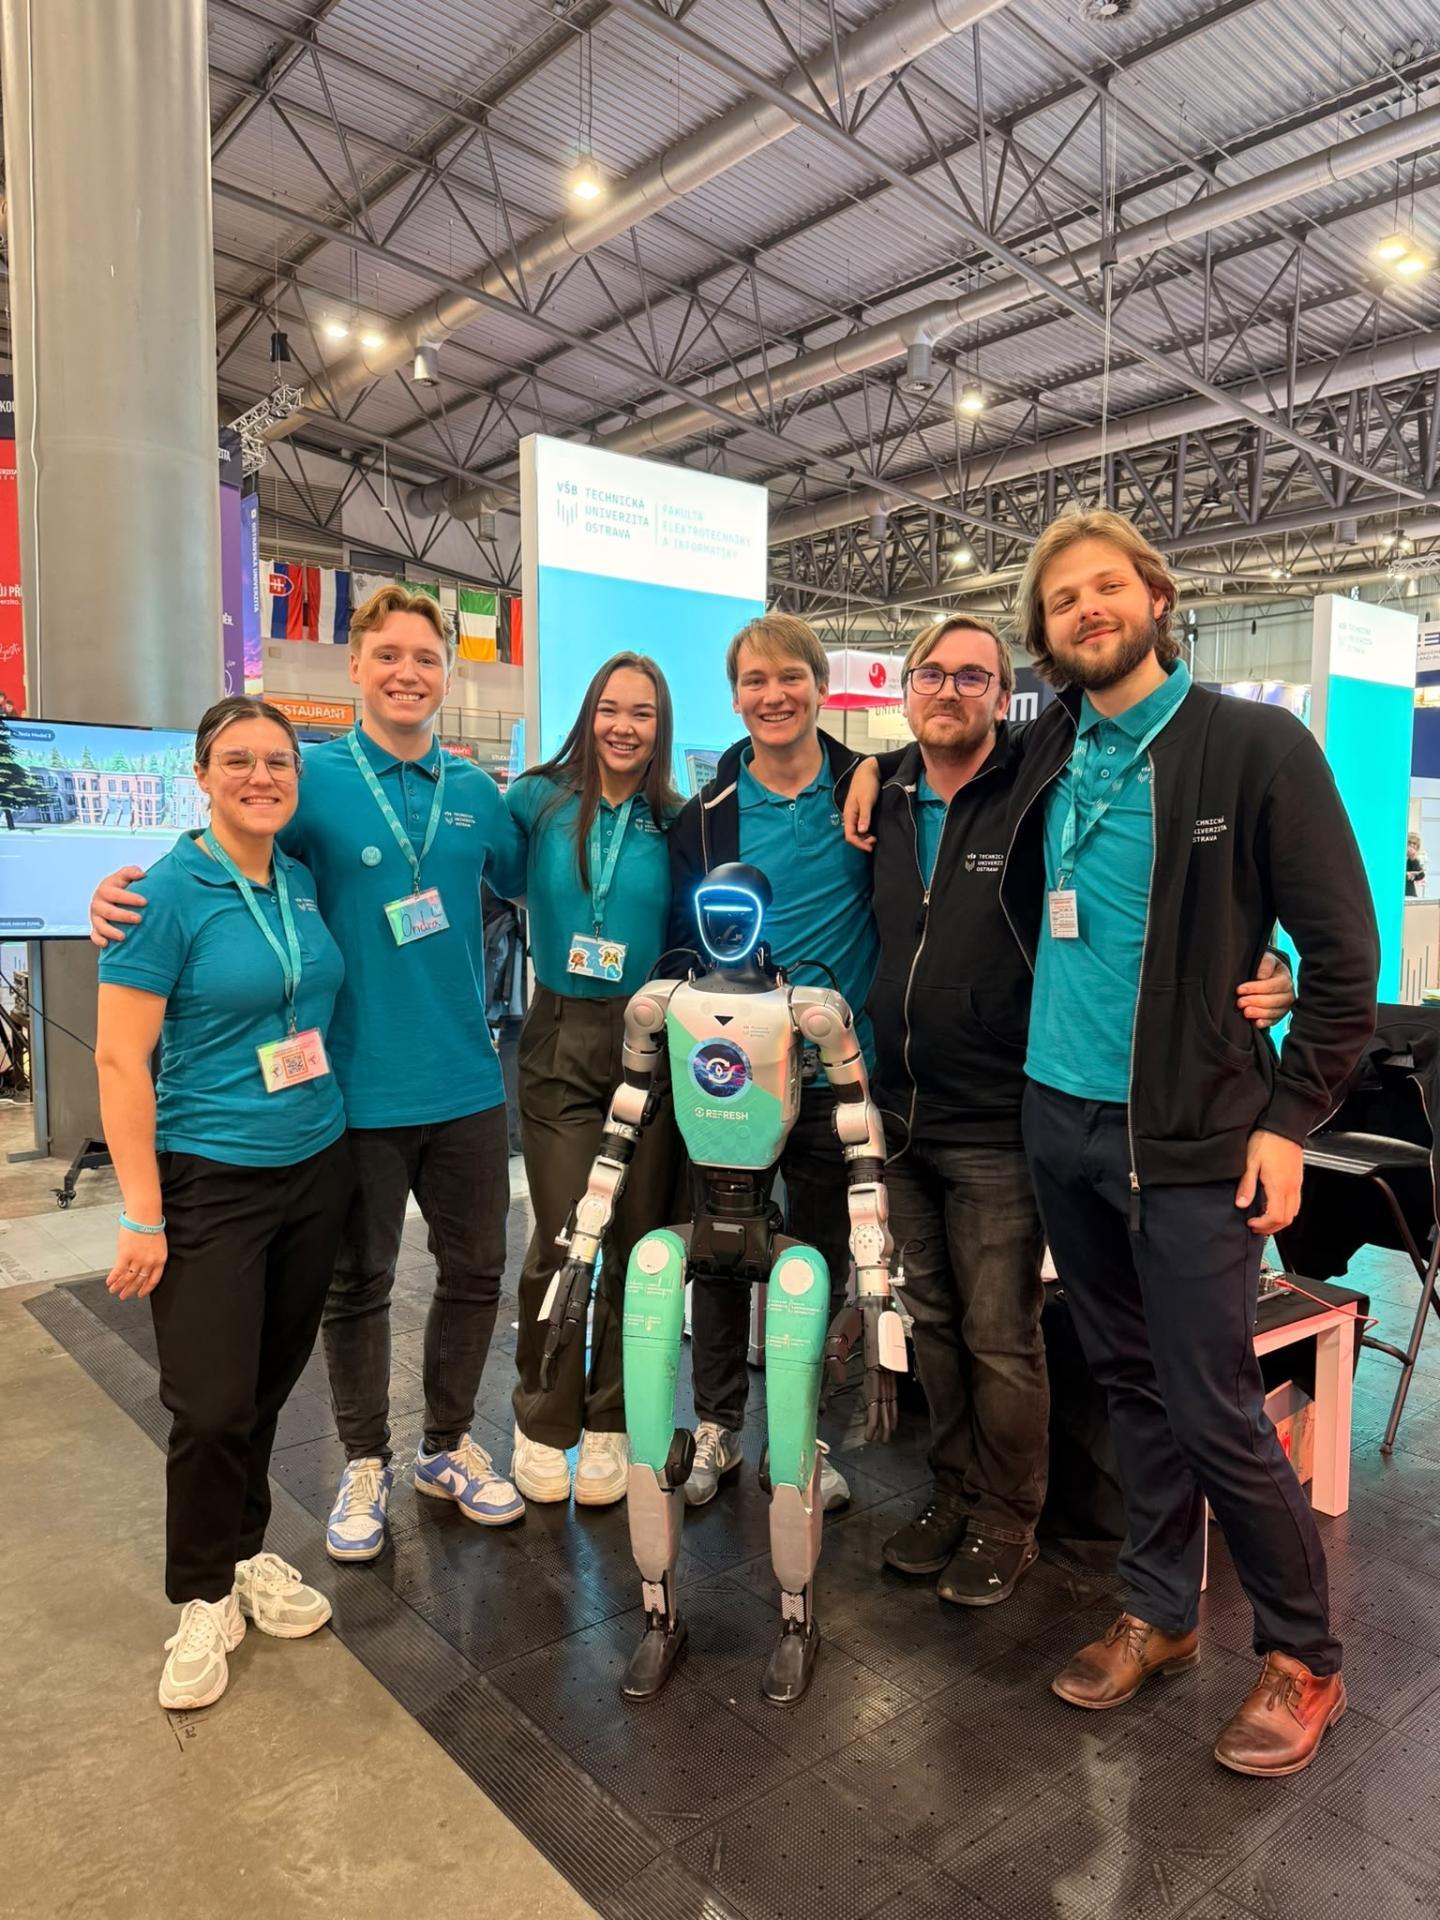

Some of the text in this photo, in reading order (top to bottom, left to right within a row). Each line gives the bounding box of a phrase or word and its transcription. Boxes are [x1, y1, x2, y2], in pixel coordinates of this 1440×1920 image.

[557, 481, 645, 510] VŠB TECHNICKÁ
[585, 505, 650, 527] UNIVERZITA
[662, 504, 704, 522] FAKULTA
[585, 521, 631, 540] OSTRAVA
[705, 1109, 749, 1121] REFRESH
